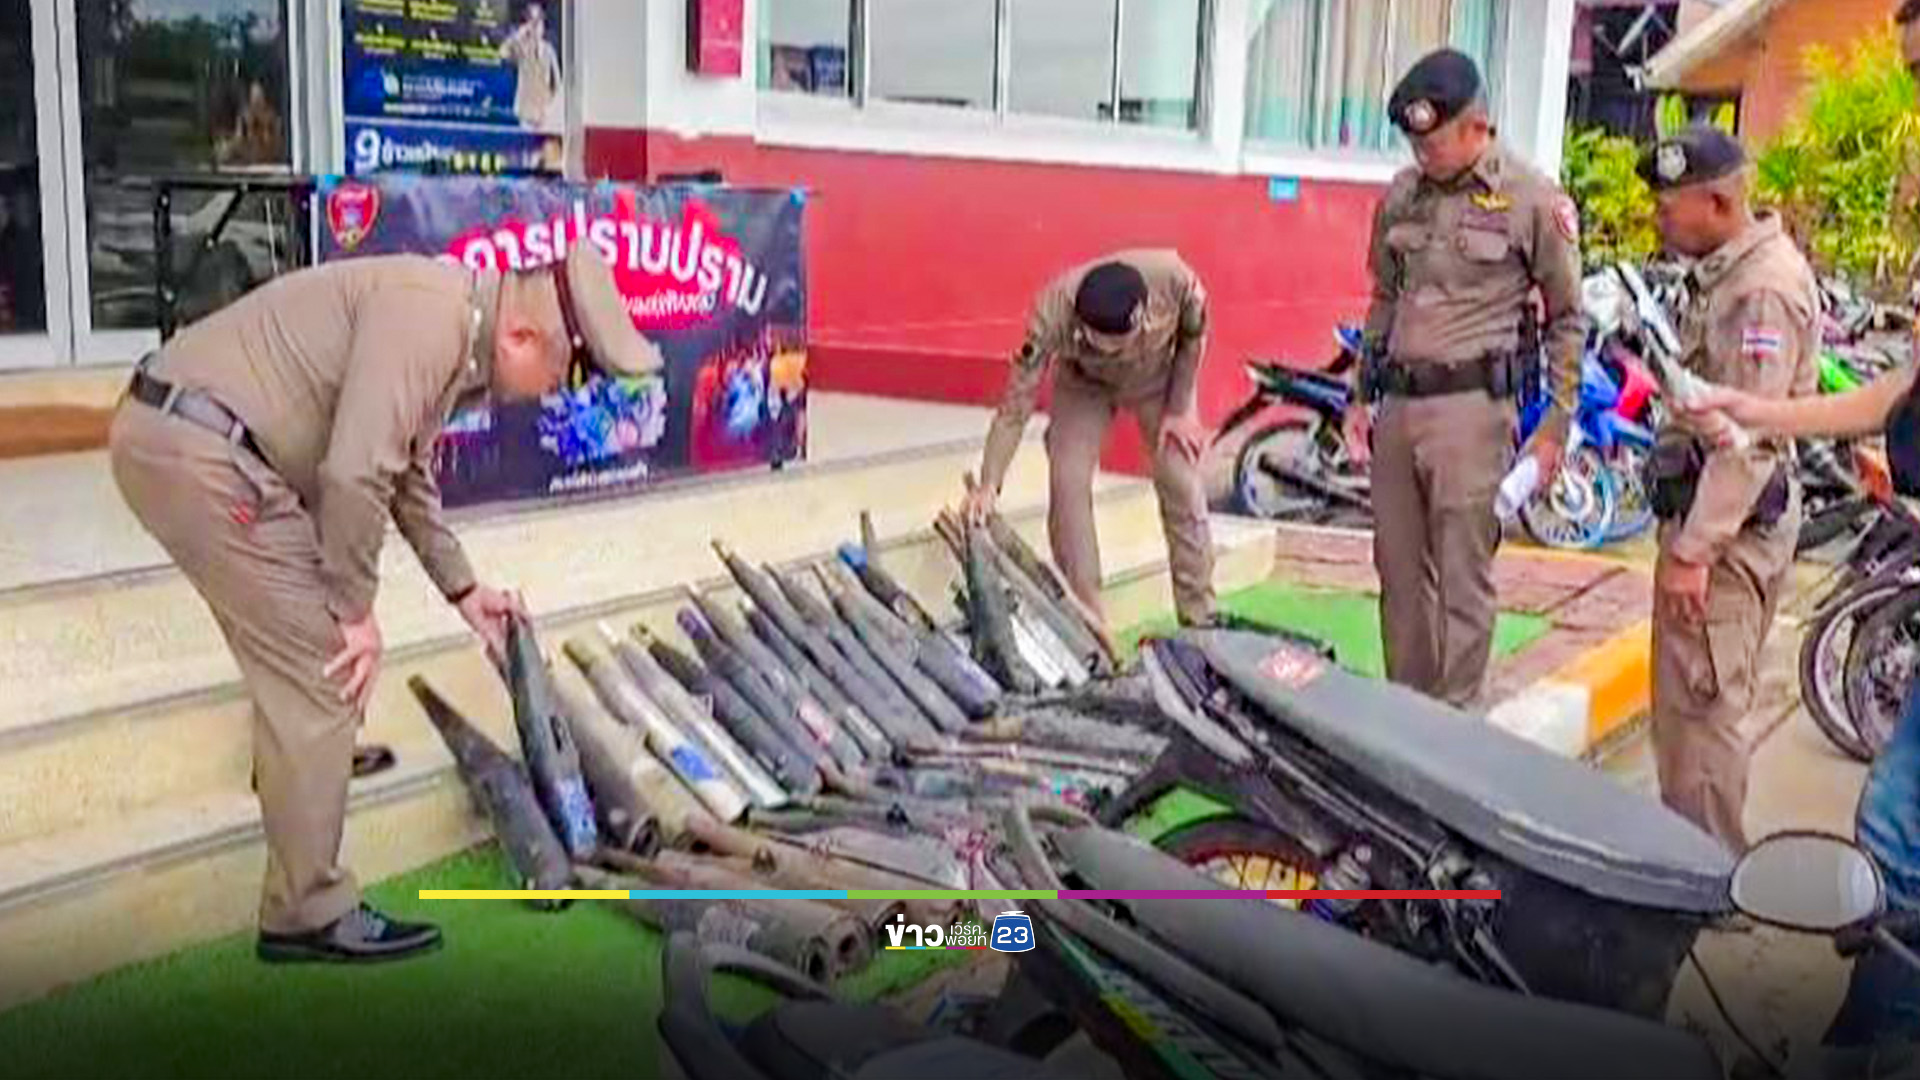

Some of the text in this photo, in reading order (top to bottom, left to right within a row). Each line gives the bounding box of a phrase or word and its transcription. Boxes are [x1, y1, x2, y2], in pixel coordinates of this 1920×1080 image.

[436, 199, 768, 315] การปราบปราม
